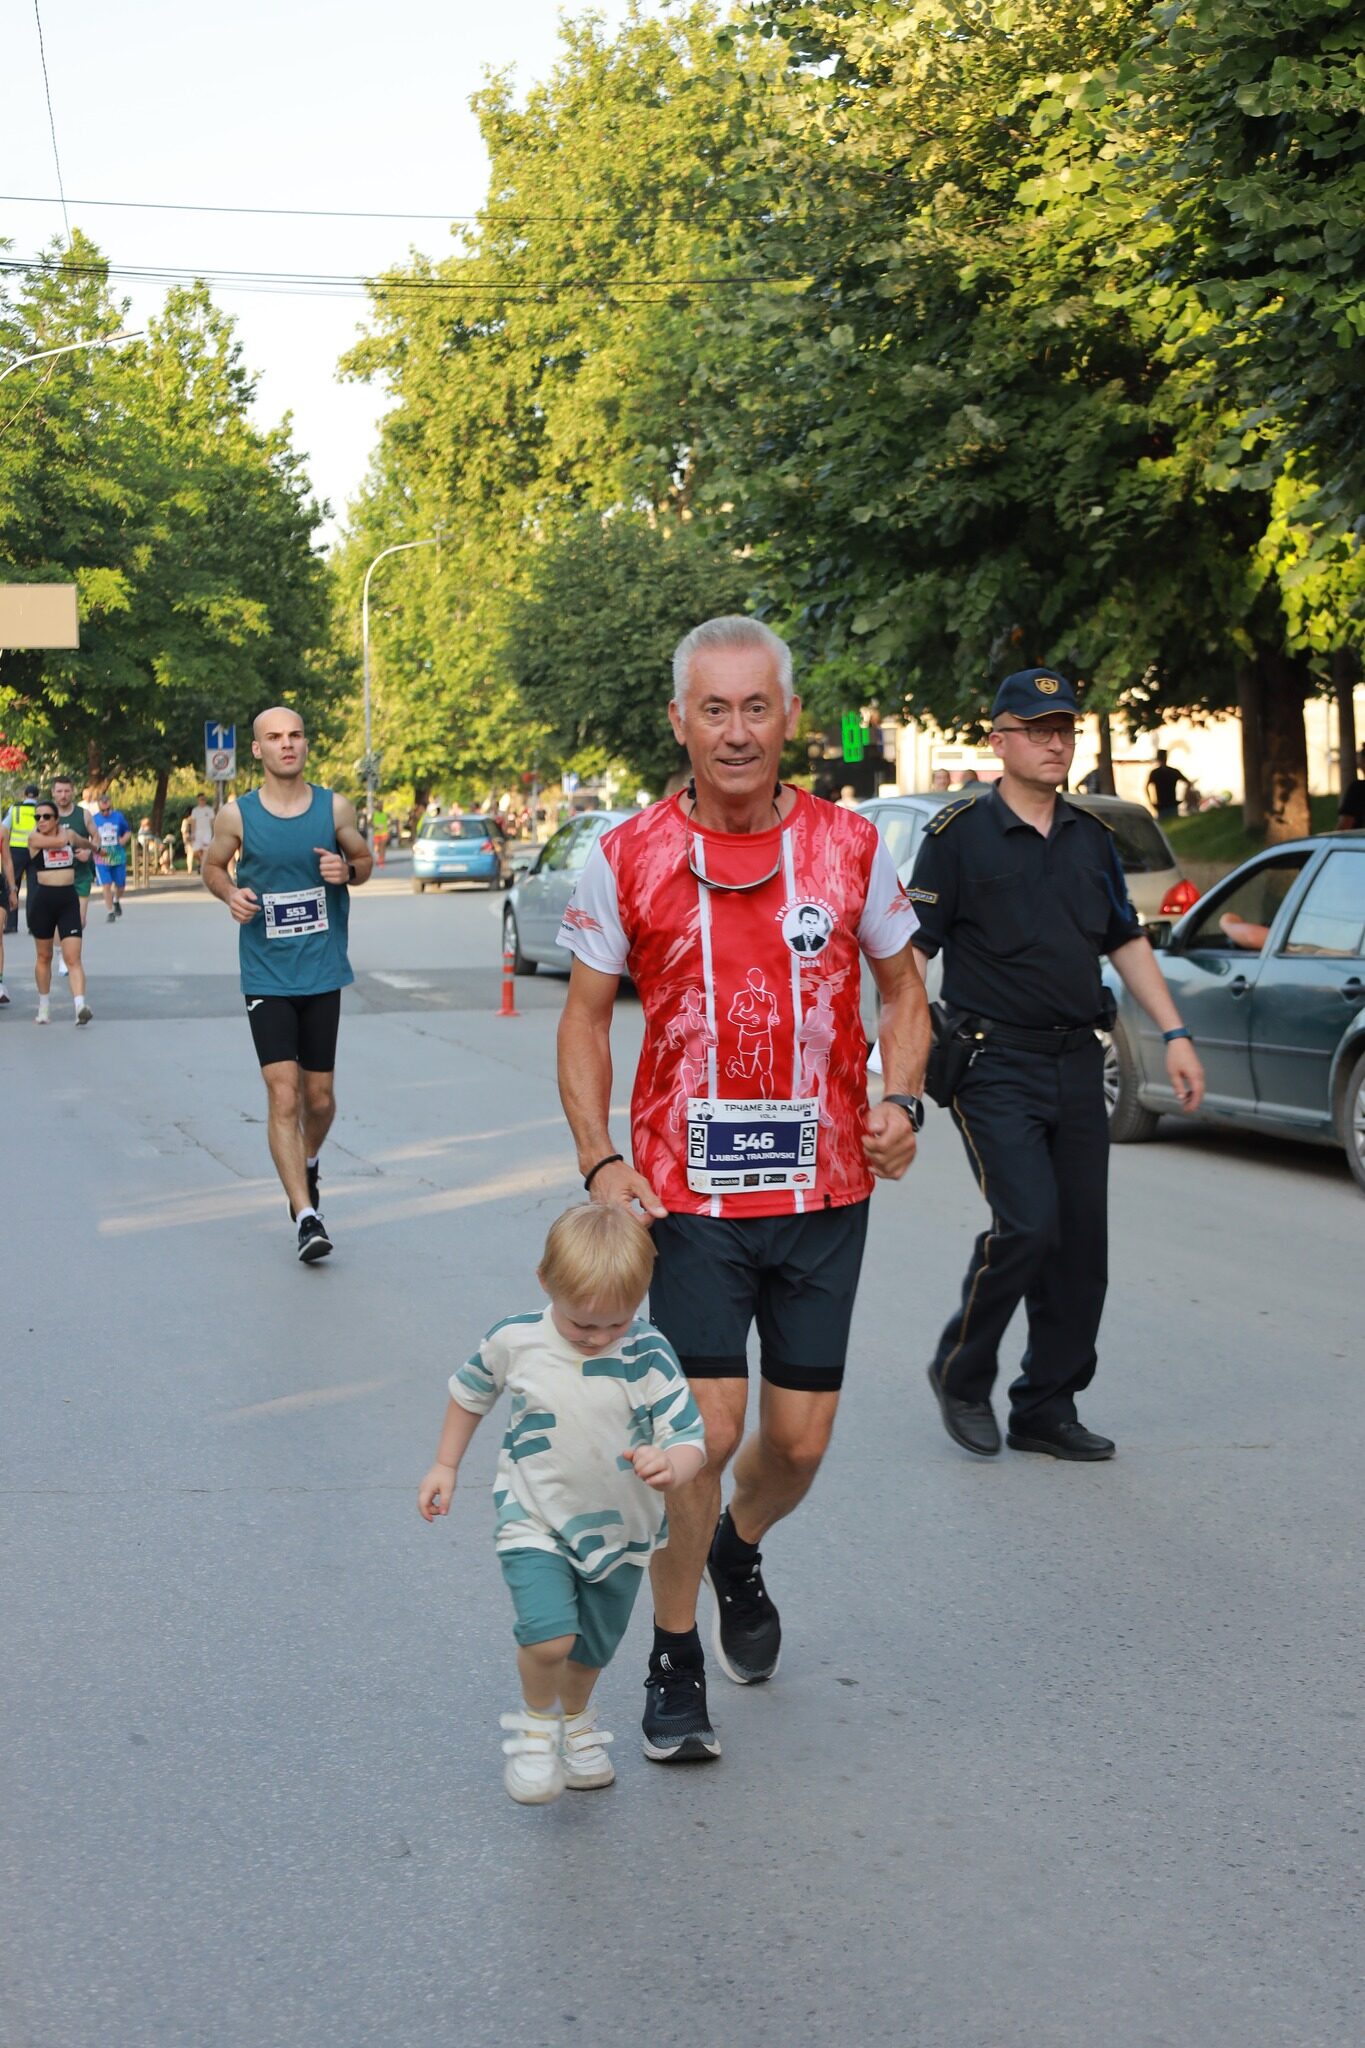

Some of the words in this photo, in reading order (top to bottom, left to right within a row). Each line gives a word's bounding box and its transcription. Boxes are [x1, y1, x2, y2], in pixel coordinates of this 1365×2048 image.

[286, 906, 307, 918] 553
[724, 1103, 763, 1112] ТРЧАМЕ
[765, 1103, 778, 1111] ЗА
[780, 1102, 812, 1112] РАЦИН
[732, 1132, 775, 1151] 546
[709, 1154, 745, 1162] LJUBISA
[746, 1151, 796, 1160] TRAJKOVSKI
